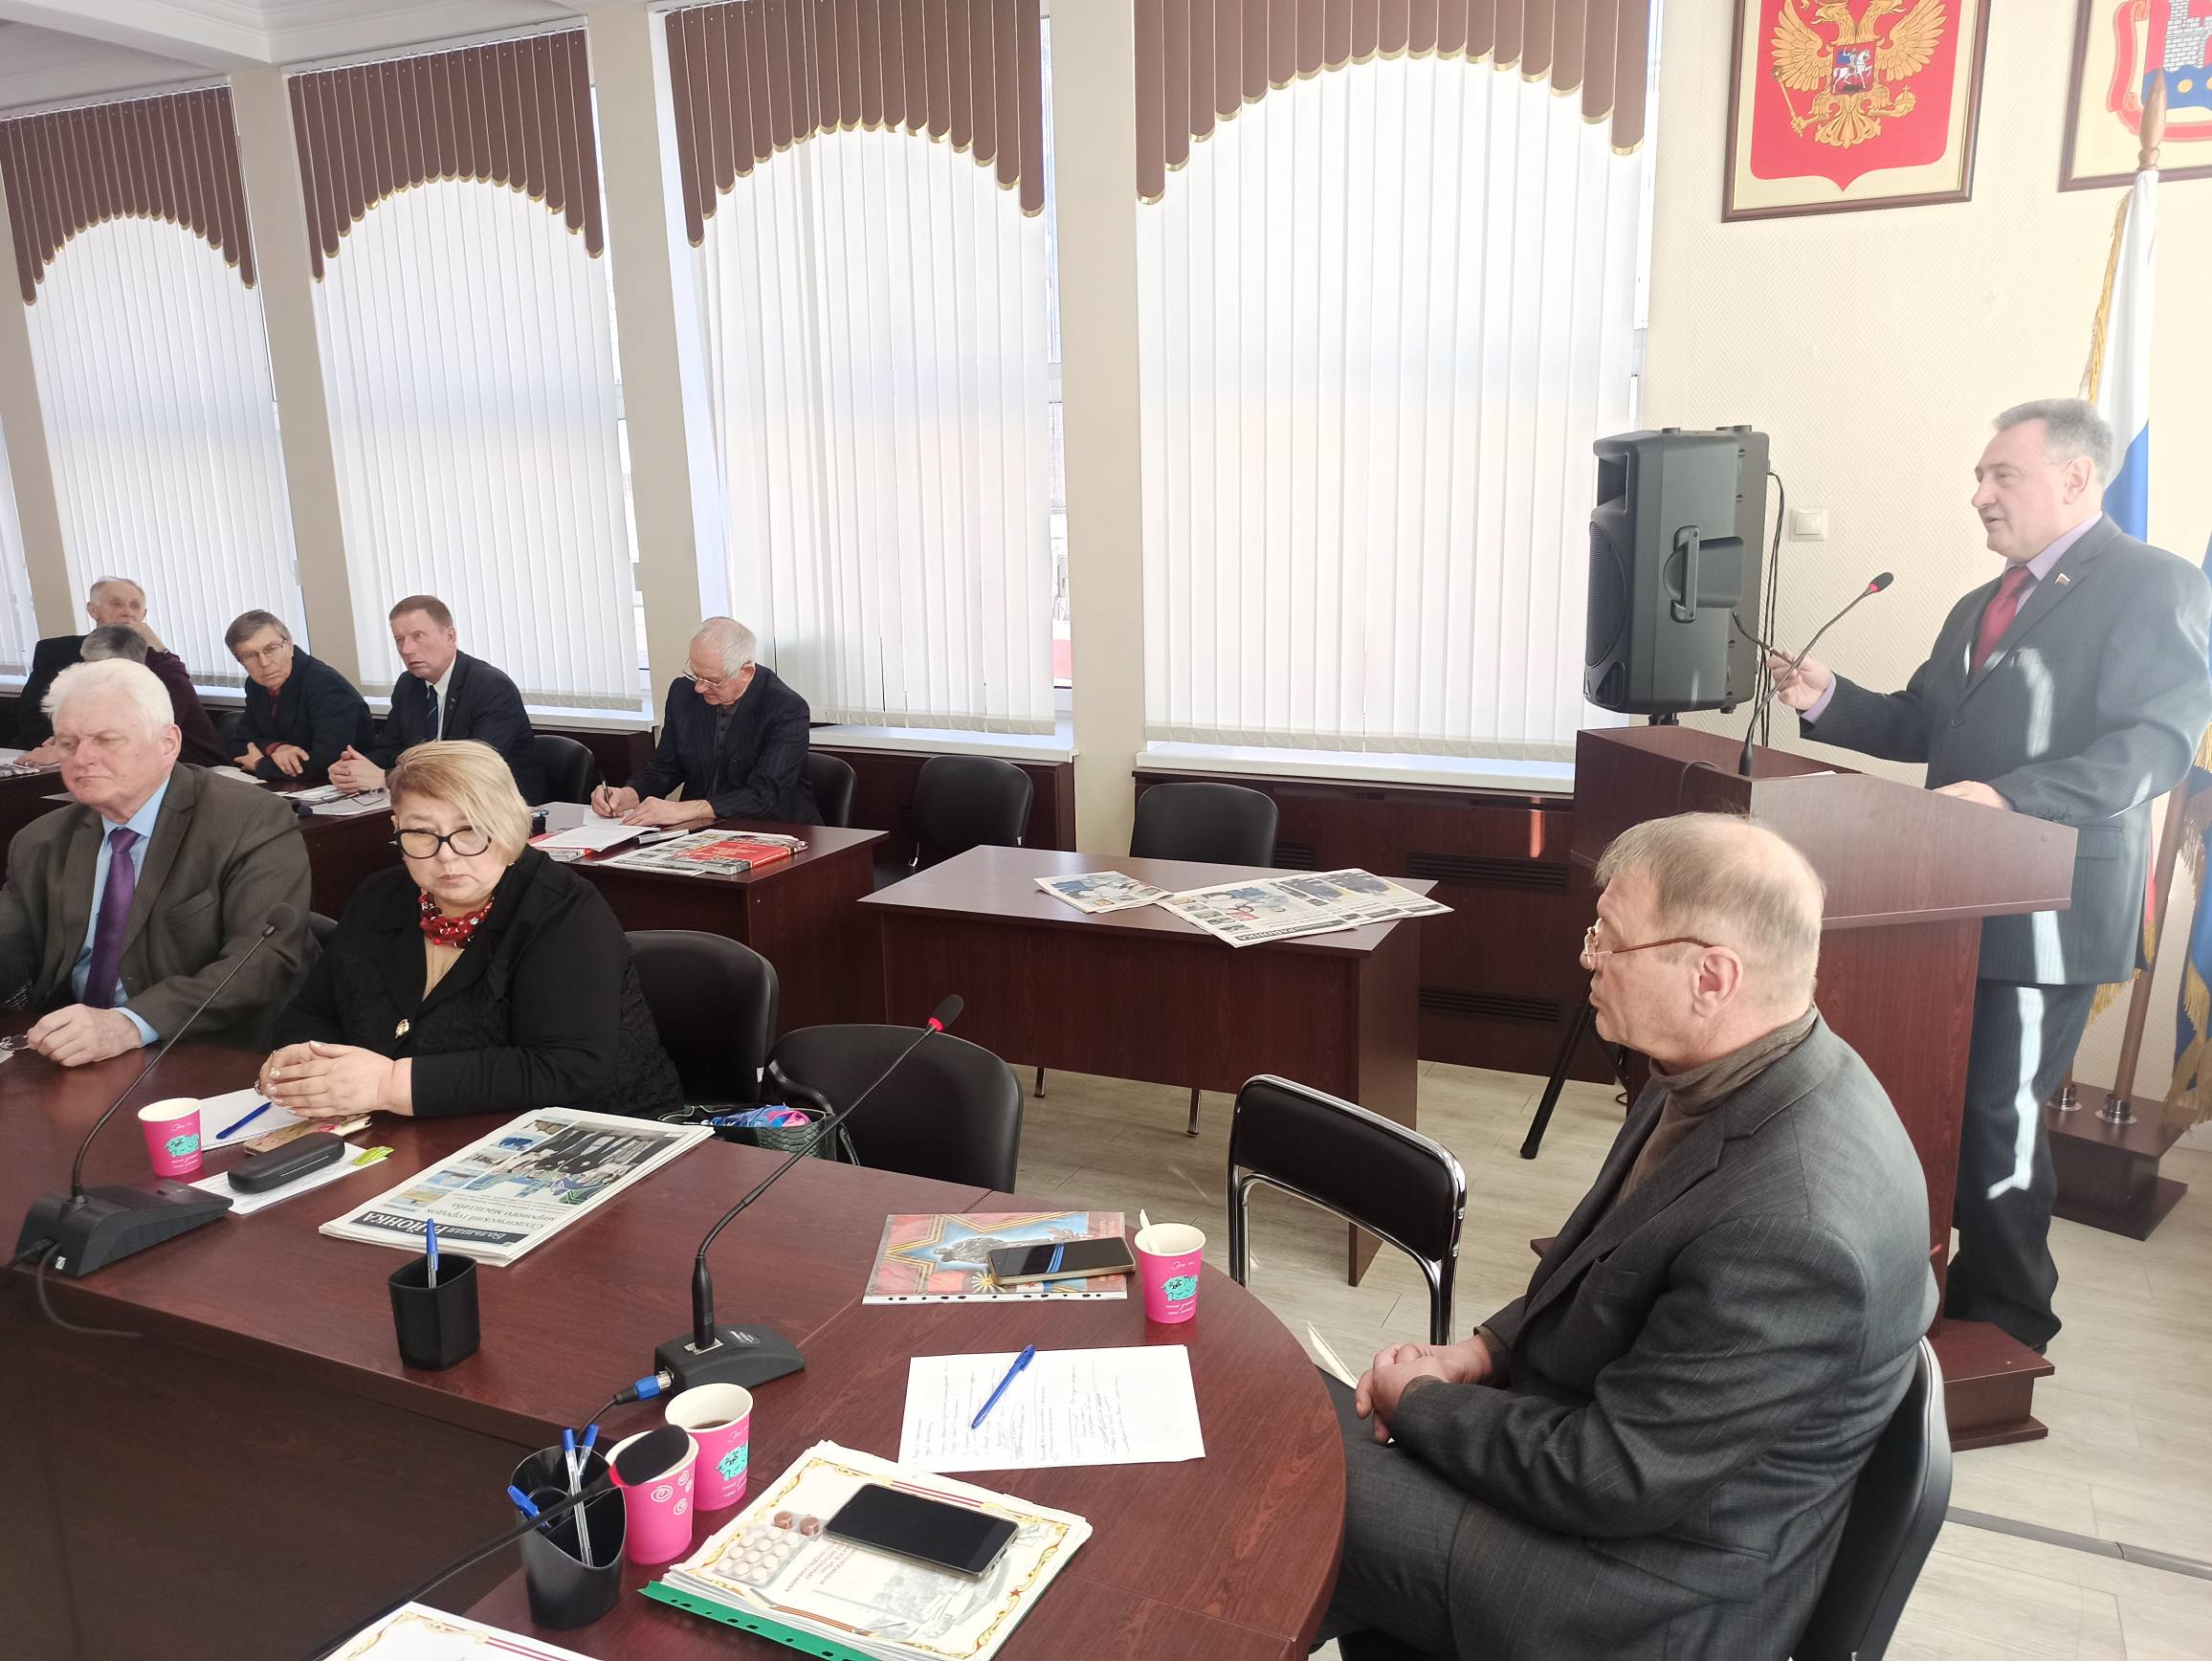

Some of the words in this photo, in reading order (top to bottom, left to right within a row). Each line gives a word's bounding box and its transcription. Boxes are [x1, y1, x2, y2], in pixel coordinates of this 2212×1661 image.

[427, 1207, 468, 1219] городок
[504, 1210, 557, 1222] мирового
[467, 1214, 543, 1229] Студенческий
[446, 1227, 507, 1240] Большая
